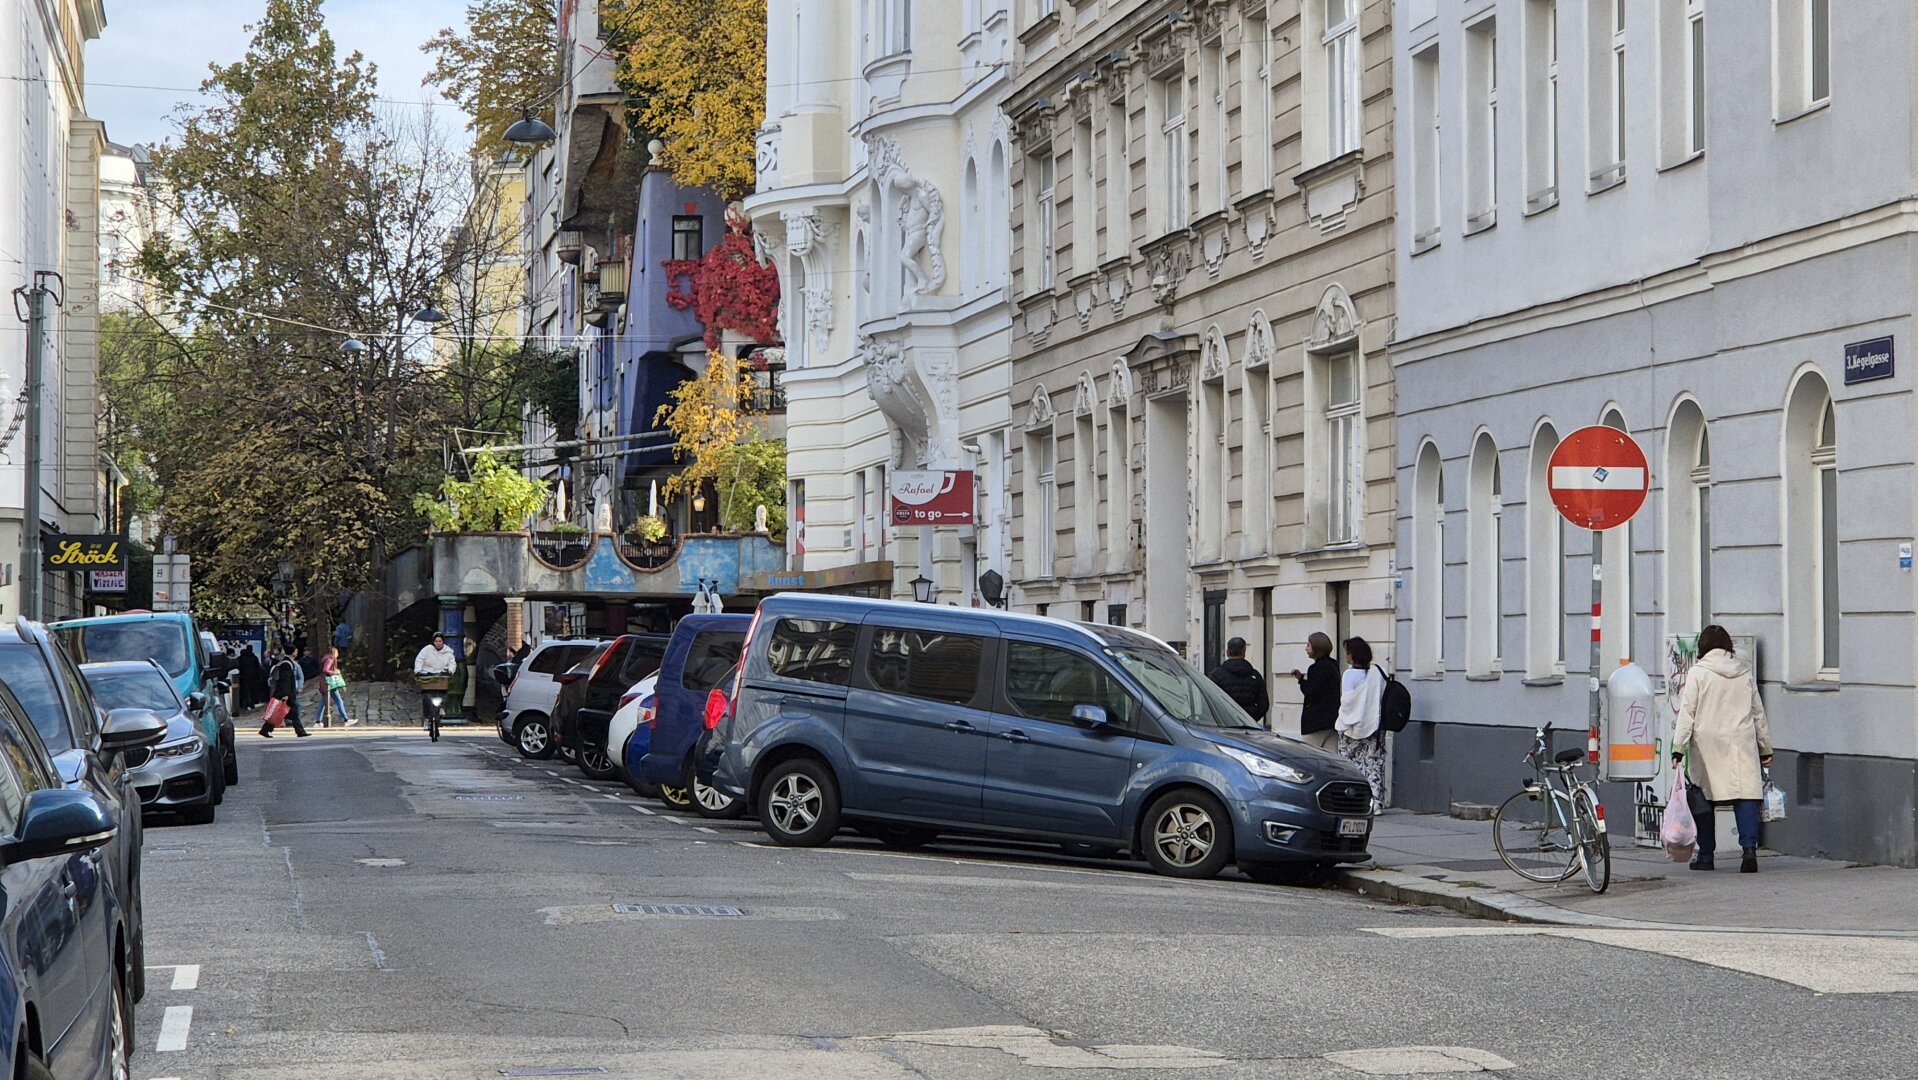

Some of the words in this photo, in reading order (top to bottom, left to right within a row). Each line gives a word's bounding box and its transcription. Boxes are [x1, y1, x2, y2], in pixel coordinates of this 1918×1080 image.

[1852, 352, 1889, 370] Kegelgasse
[899, 482, 935, 495] Rafael
[914, 509, 926, 518] to
[927, 510, 942, 521] go
[50, 541, 119, 564] Ströck
